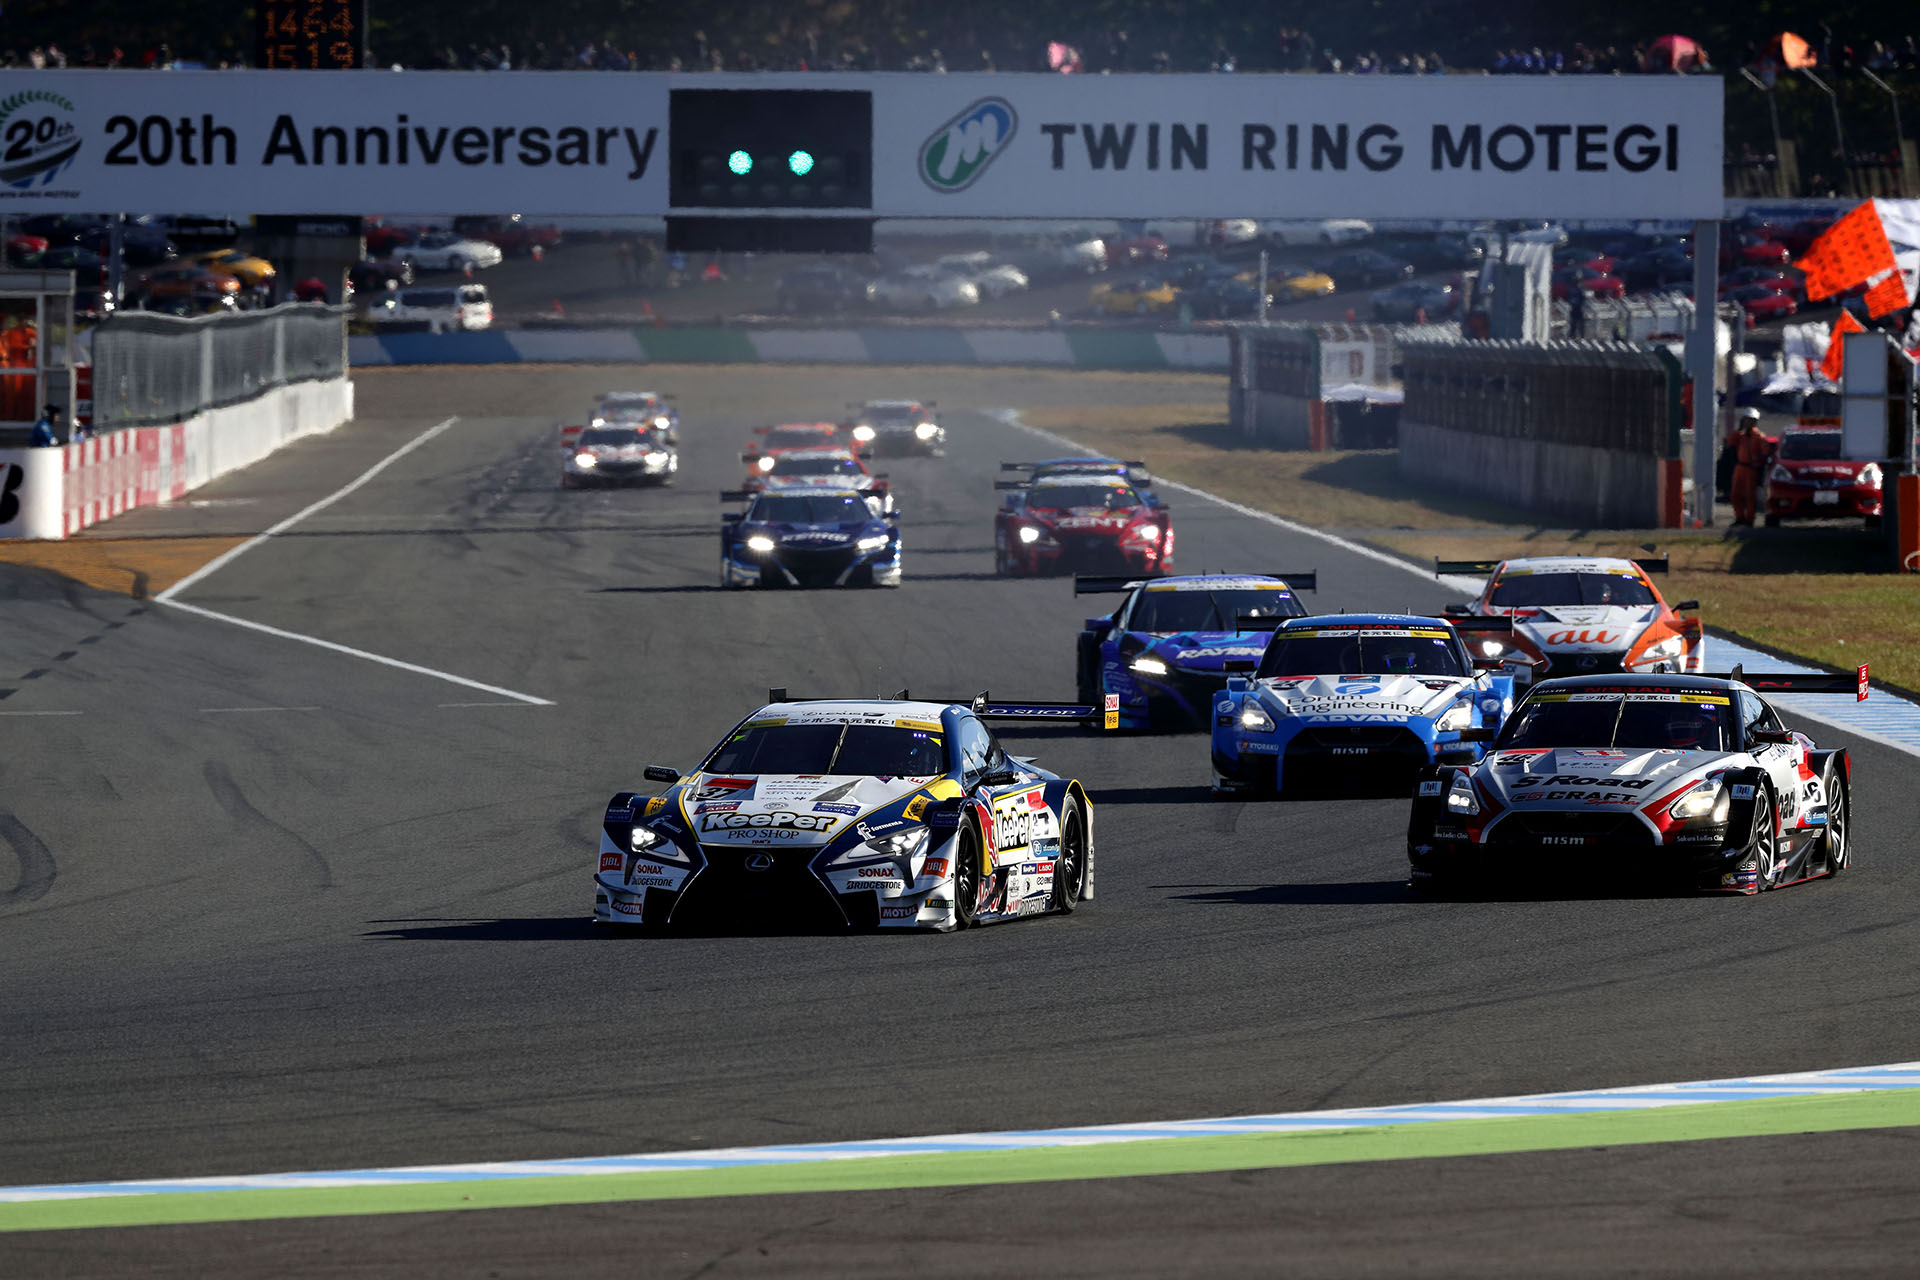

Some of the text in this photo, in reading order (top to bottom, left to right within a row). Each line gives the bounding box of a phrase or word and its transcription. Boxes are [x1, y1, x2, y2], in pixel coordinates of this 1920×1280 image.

[264, 8, 299, 38] 14
[103, 114, 659, 180] 20th Anniversary
[1040, 124, 1679, 171] TWIN RING MOTEGI
[1055, 517, 1128, 528] ZENT
[1546, 629, 1621, 645] au
[1584, 686, 1670, 694] NISSAN
[1287, 694, 1363, 704] Forum
[1013, 708, 1077, 716] SHOP
[1286, 701, 1424, 717] Engineering
[1307, 715, 1409, 723] ADVAN
[1511, 775, 1656, 790] S Road
[1545, 790, 1638, 802] CRAFT
[702, 811, 839, 834] KeePer
[996, 807, 1030, 849] KeePer
[728, 828, 800, 840] PRO SHOP
[601, 856, 620, 867] JBL
[926, 861, 944, 873] JBL
[637, 864, 663, 875] SONAX
[858, 867, 895, 878] SONAX
[846, 880, 902, 890] BRIDGESTONE
[613, 902, 642, 915] MOTUL
[882, 904, 918, 918] MOTUL
